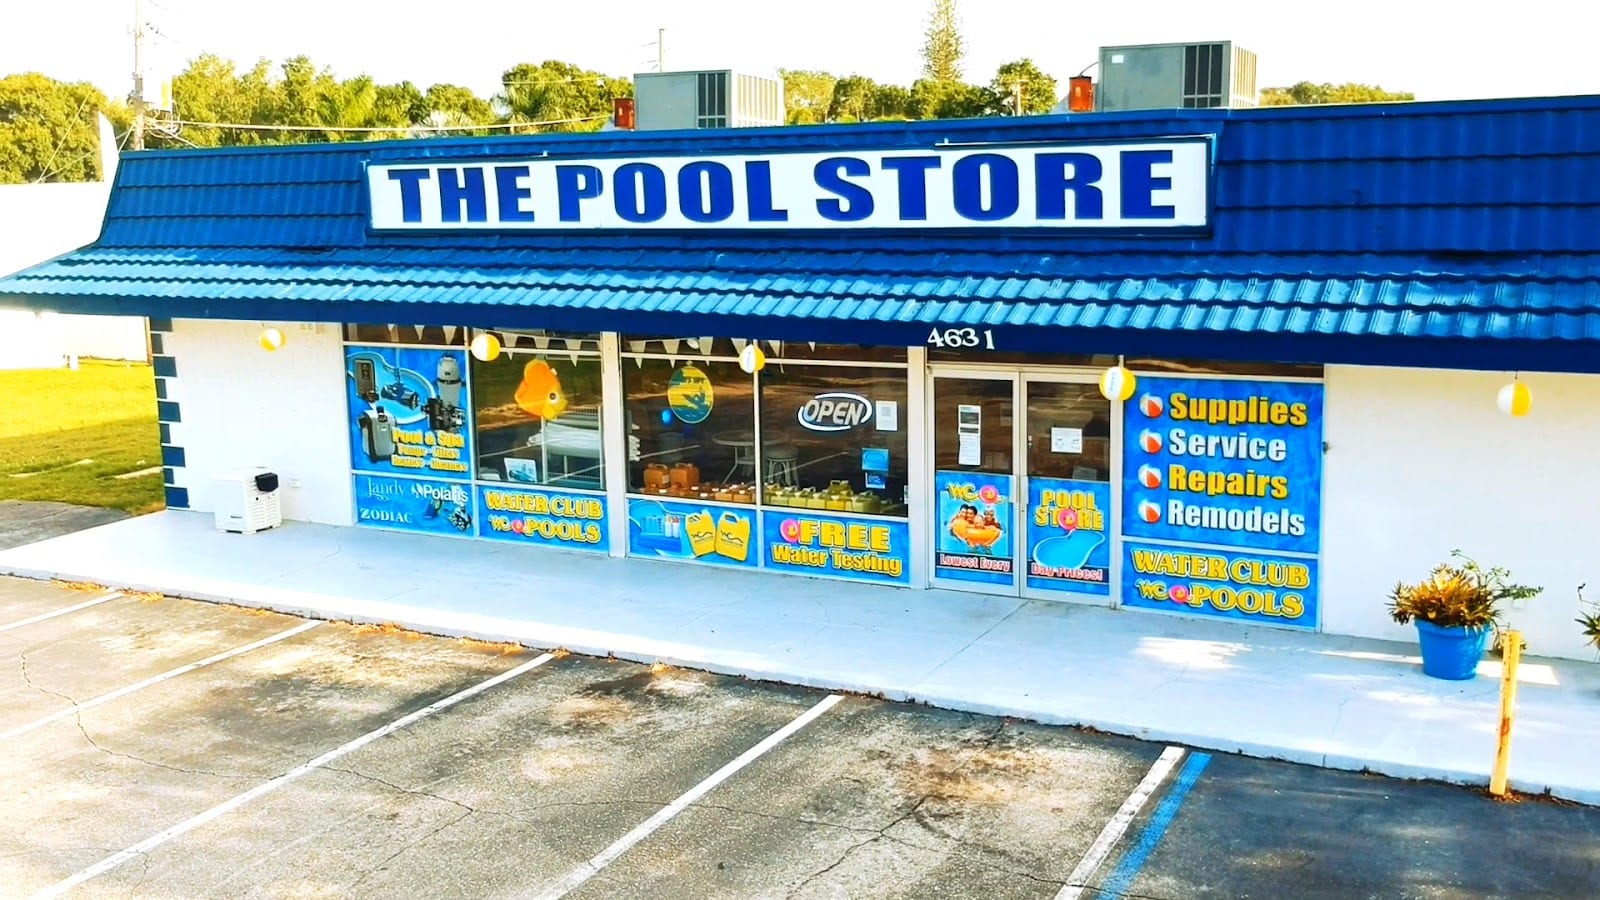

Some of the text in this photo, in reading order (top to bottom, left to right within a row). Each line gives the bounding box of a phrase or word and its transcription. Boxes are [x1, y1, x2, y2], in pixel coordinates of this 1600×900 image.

[387, 149, 1176, 224] THE POOL STORE
[927, 327, 995, 350] 4631
[803, 400, 864, 425] OPEN
[1168, 393, 1308, 426] Supplies
[1168, 428, 1287, 461] Service
[423, 485, 468, 503] Polaris
[946, 482, 981, 503] WC
[1168, 463, 1288, 499] Repairs
[360, 508, 412, 523] ZODIAC
[484, 489, 603, 519] WATER CLUB
[1042, 490, 1096, 511] POOL
[524, 517, 601, 543] POOLS
[1167, 499, 1306, 537] Remodels
[798, 518, 891, 552] FREE
[771, 542, 903, 577] Water Testing
[940, 554, 1011, 572] Lowest Every
[1132, 549, 1310, 588] WATER CLUB
[1189, 583, 1304, 618] POOLS
